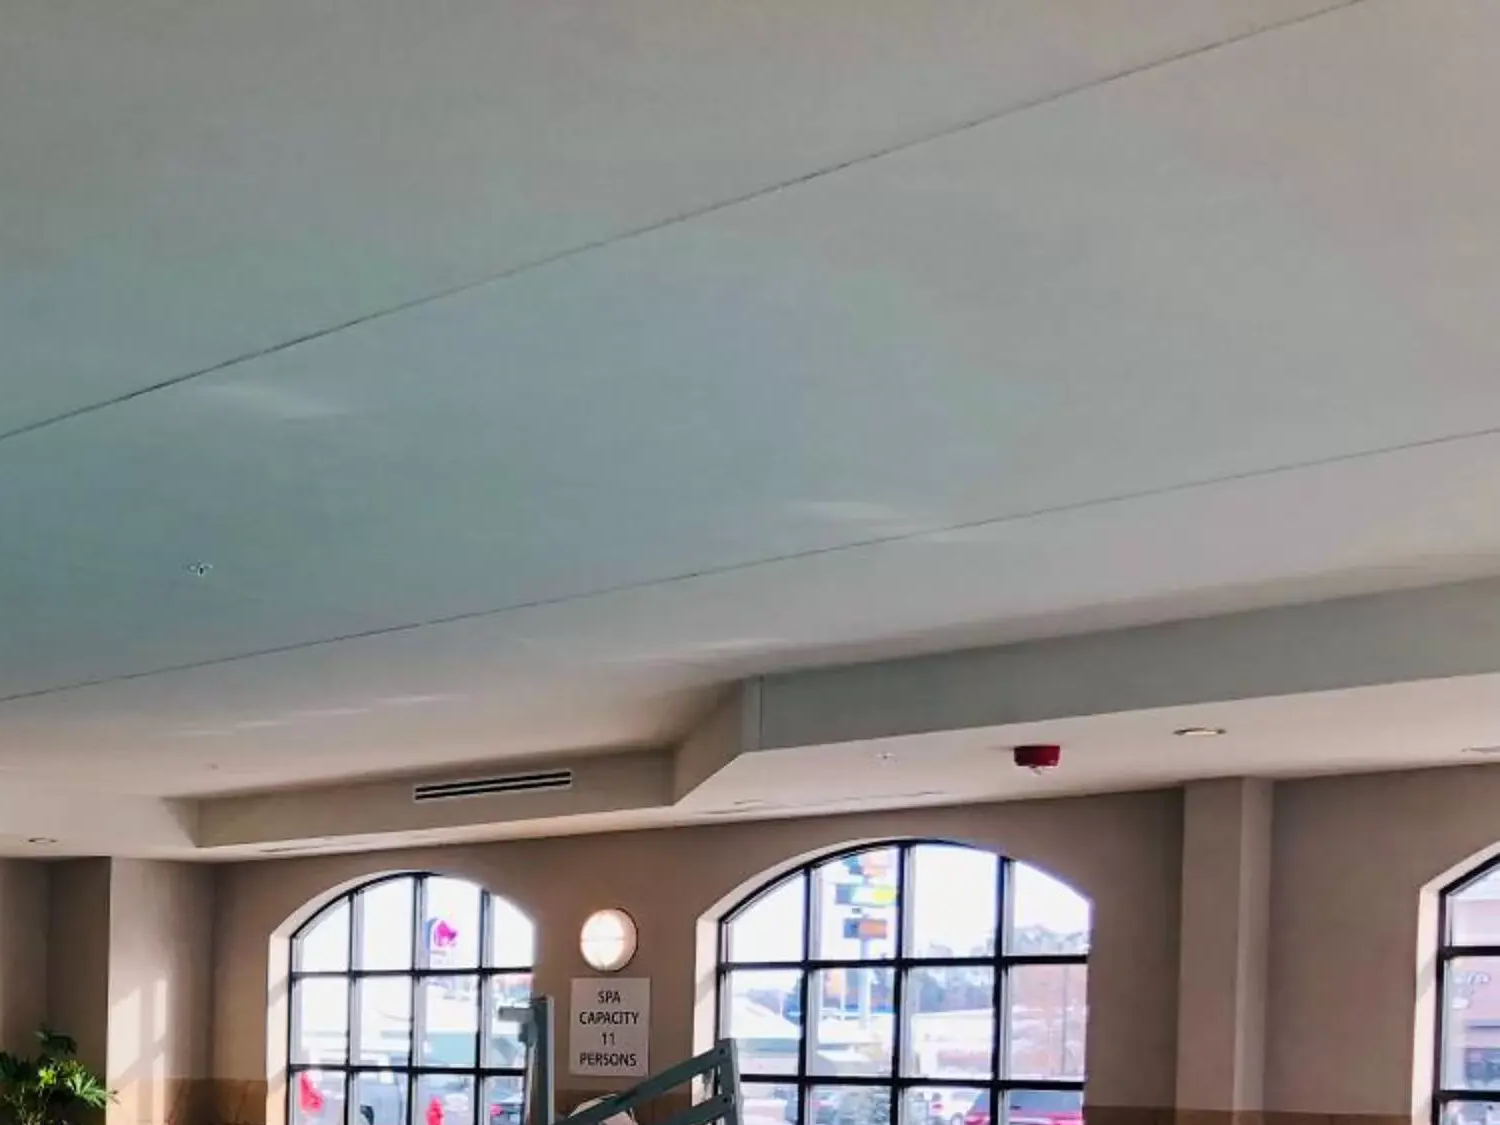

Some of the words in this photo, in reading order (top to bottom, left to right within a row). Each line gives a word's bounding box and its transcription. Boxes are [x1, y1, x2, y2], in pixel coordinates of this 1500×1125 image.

[597, 990, 621, 1004] SPA
[579, 1011, 639, 1025] CAPACITY
[601, 1032, 616, 1046] 11
[579, 1052, 637, 1067] PERSONS
